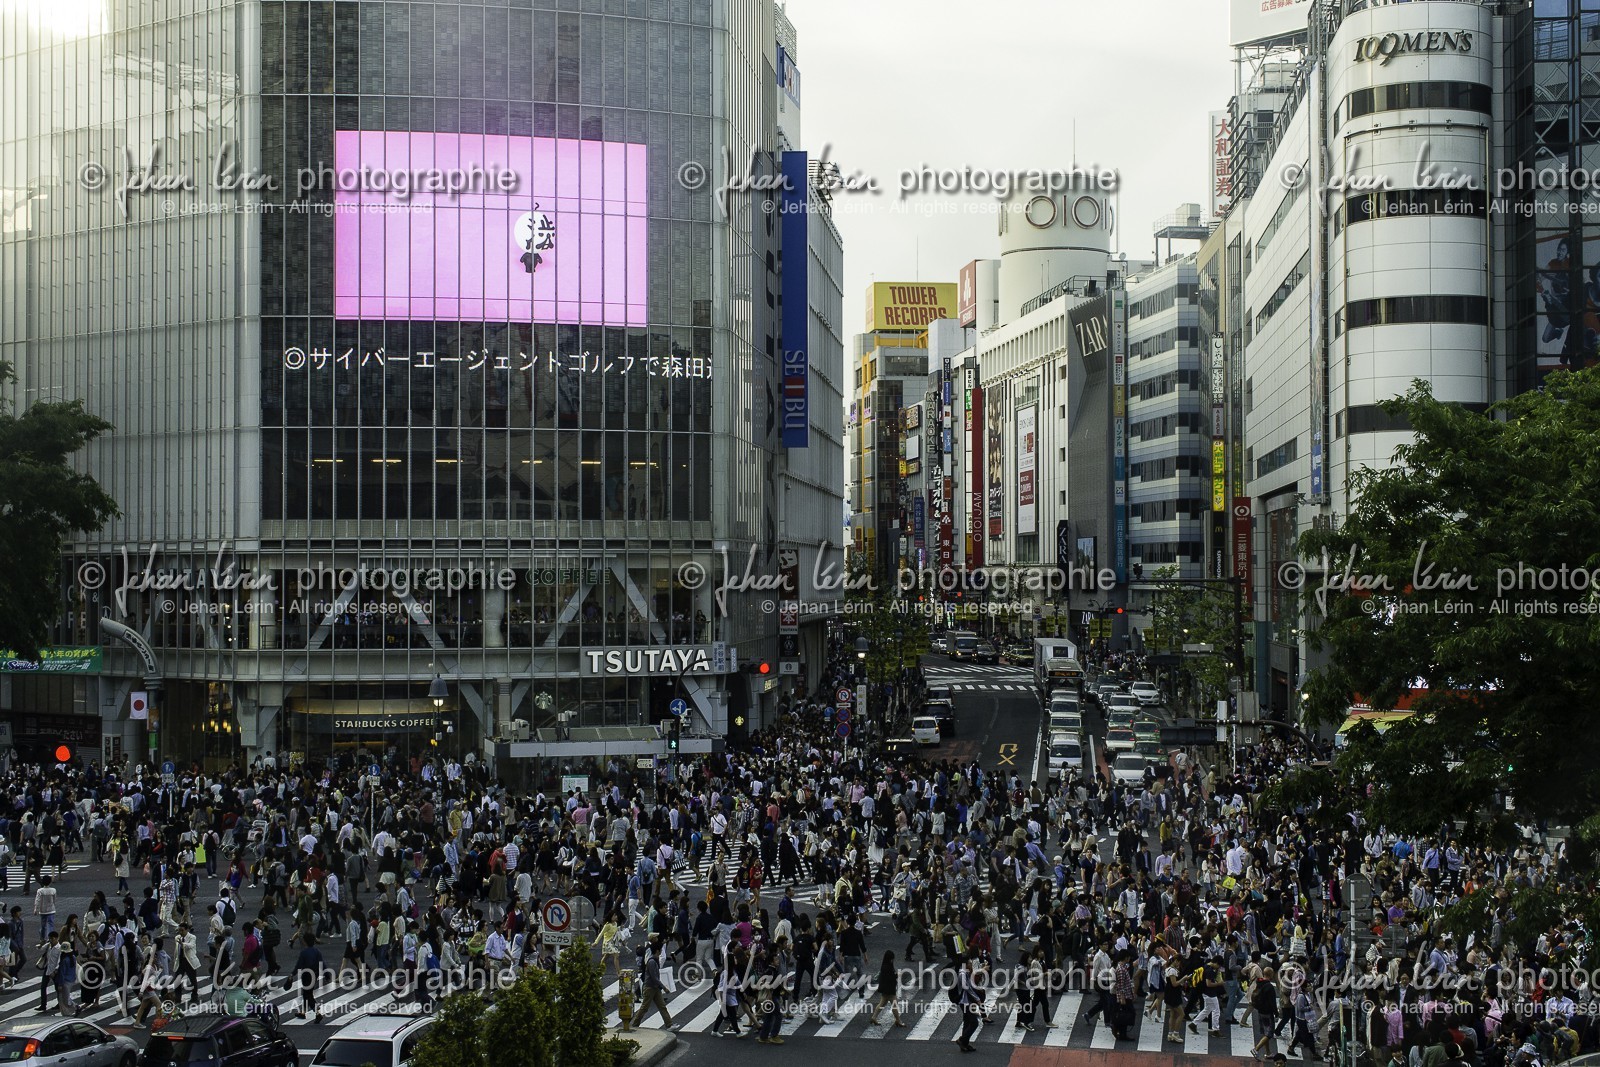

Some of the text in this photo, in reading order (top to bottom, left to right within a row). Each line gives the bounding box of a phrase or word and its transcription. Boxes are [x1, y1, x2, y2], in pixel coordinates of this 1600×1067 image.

[889, 286, 938, 305] TOWER
[884, 307, 947, 325] RECORDS
[784, 350, 805, 429] SEIBU
[926, 392, 937, 454] KARAOKE
[525, 569, 611, 585] COFFEE
[587, 650, 710, 672] TSUTAYA
[544, 934, 570, 945] ここから
